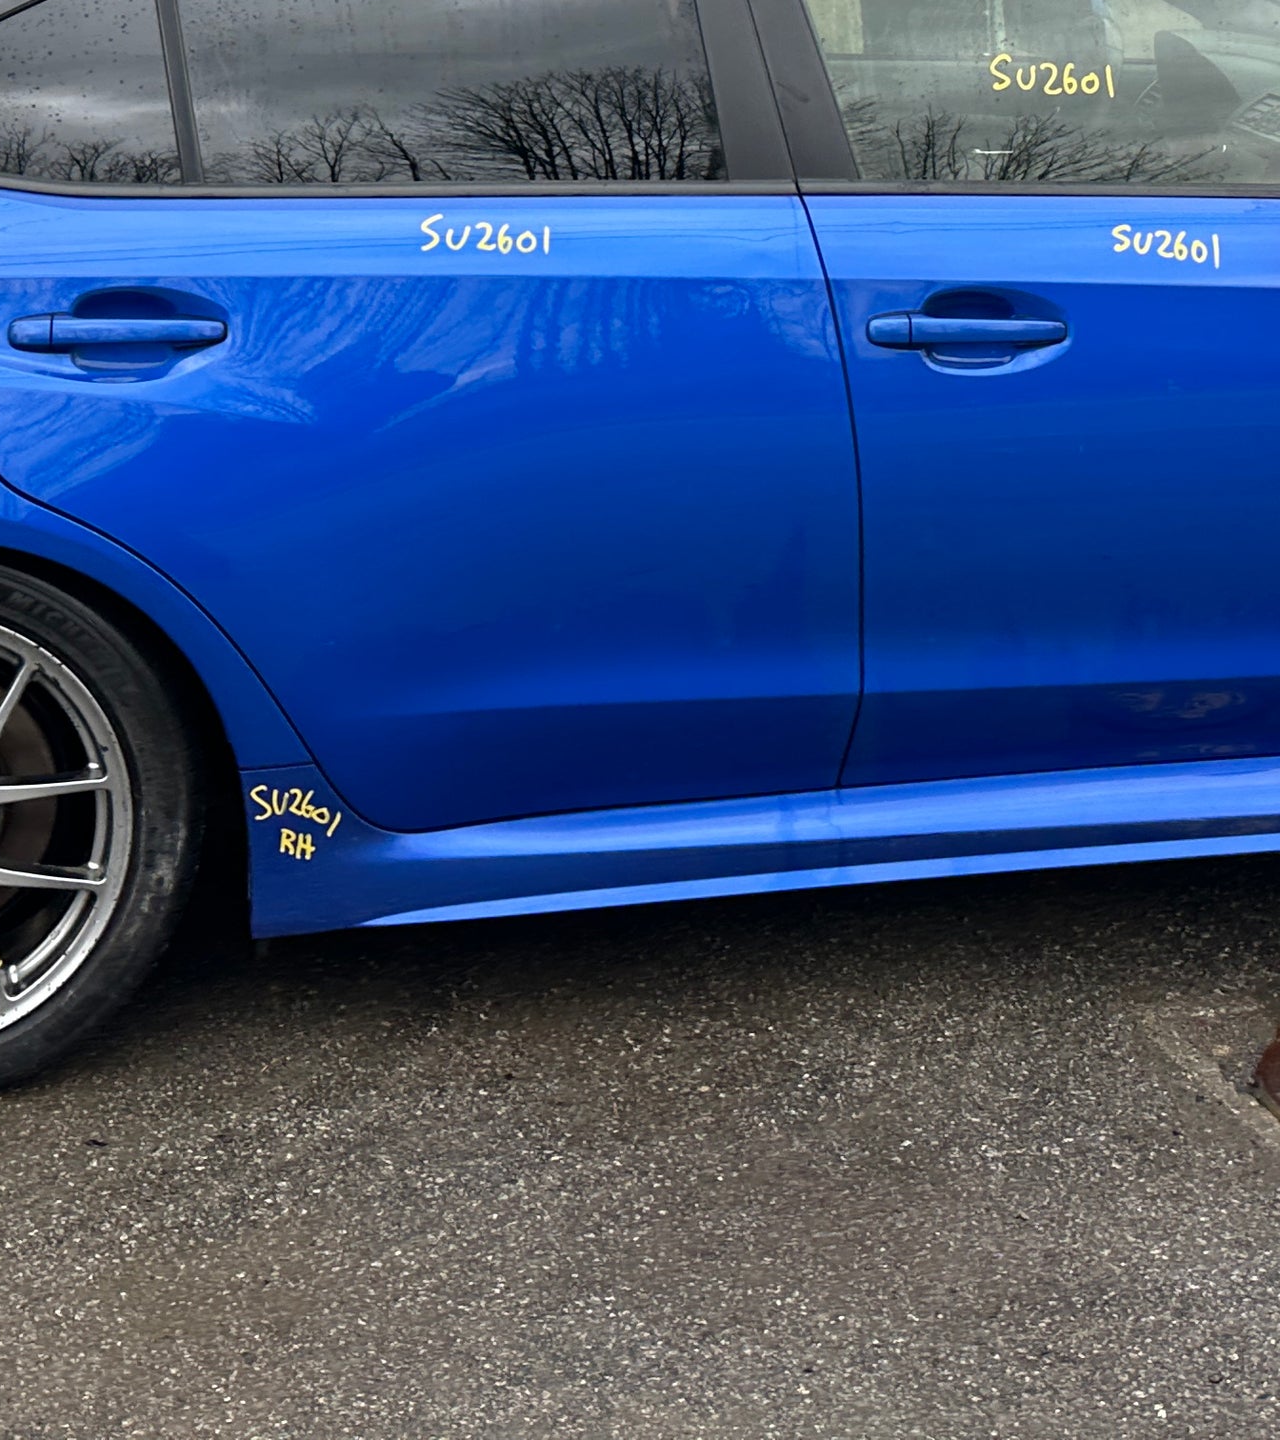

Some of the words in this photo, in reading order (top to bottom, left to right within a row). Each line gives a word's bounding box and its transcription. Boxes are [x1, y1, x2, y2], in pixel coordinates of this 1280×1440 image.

[987, 52, 1116, 100] SU2601
[419, 212, 553, 257] SU2601
[1110, 223, 1222, 270] SU2601
[249, 783, 342, 838] SU2601
[279, 827, 317, 861] RH
